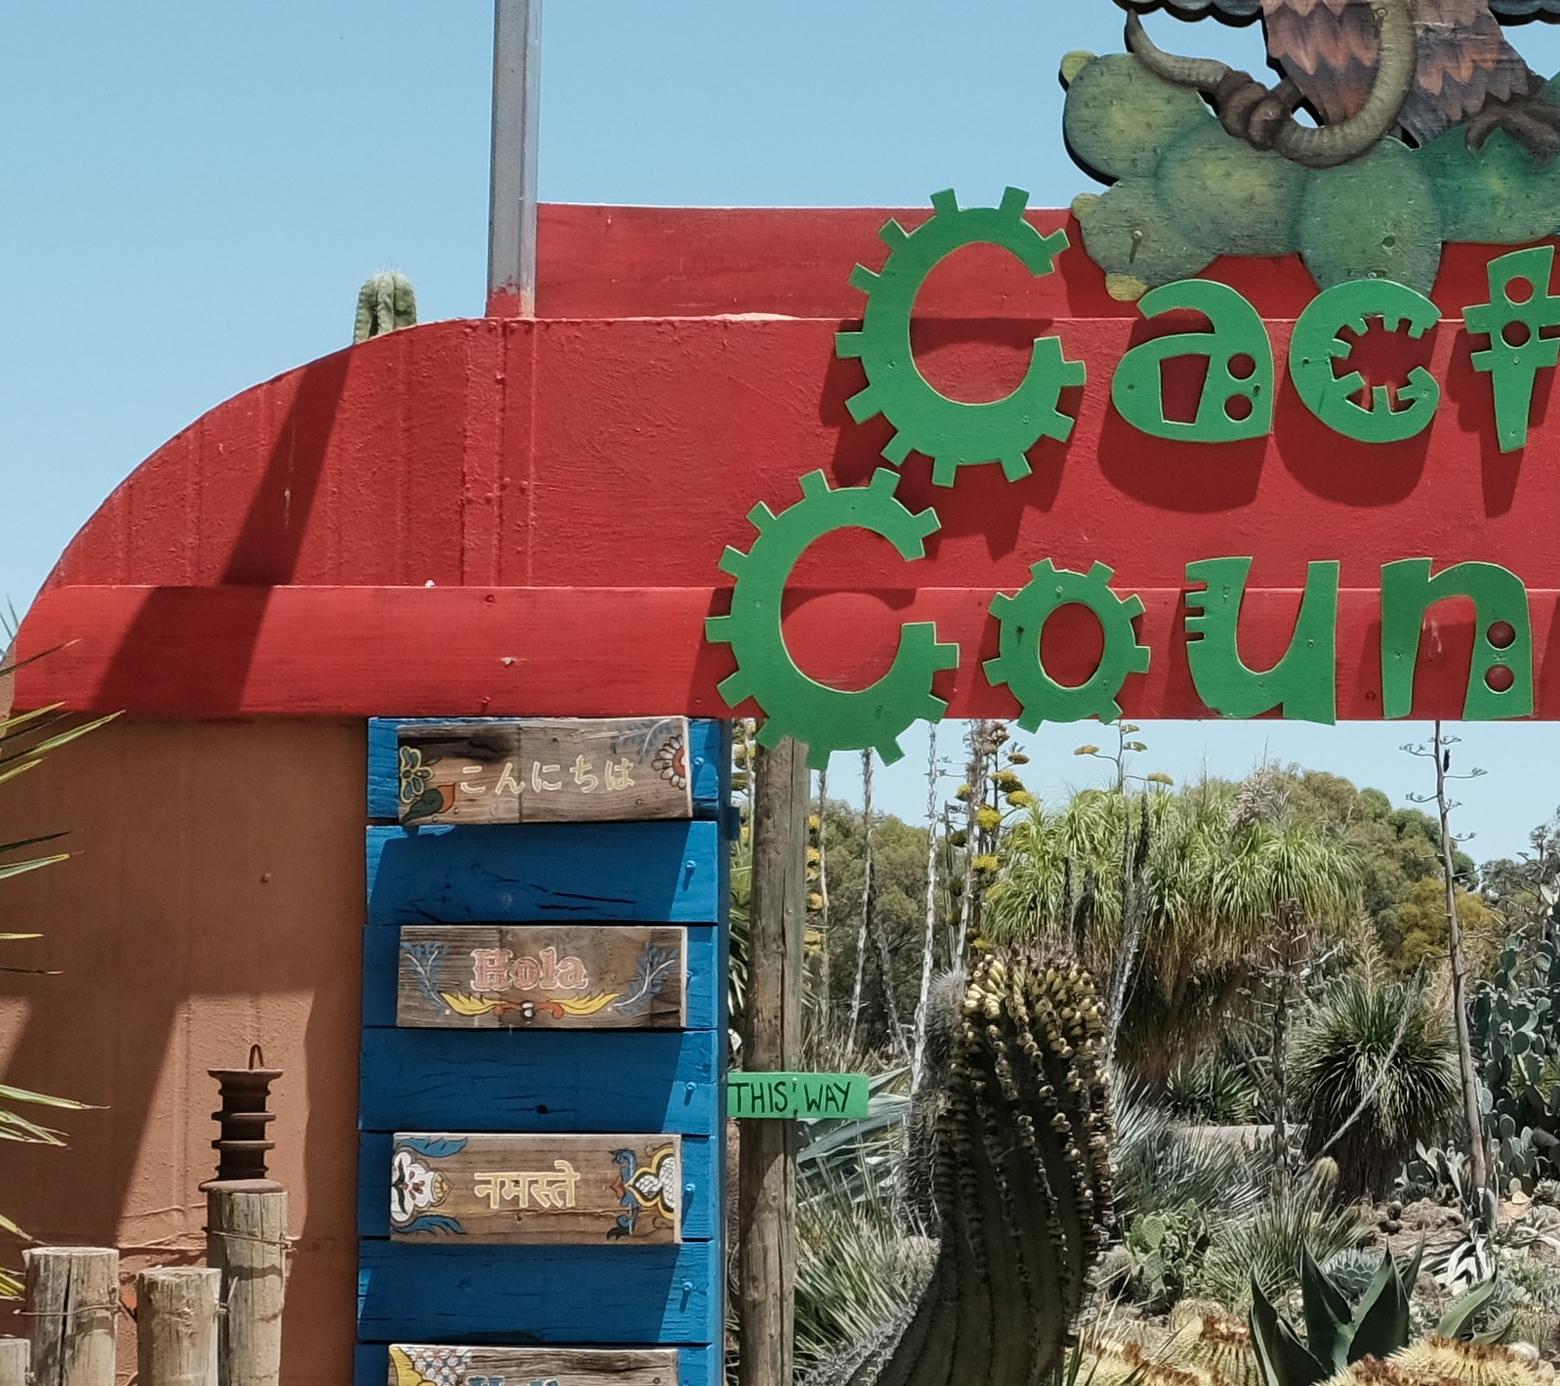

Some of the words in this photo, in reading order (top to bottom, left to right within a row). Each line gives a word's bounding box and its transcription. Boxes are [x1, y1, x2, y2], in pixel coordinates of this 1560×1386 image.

[459, 754, 637, 794] こんにちは
[469, 945, 590, 993] Hola
[727, 1080, 789, 1114] THIS
[803, 1080, 853, 1114] WAY
[473, 1159, 582, 1210] नमस्ते
